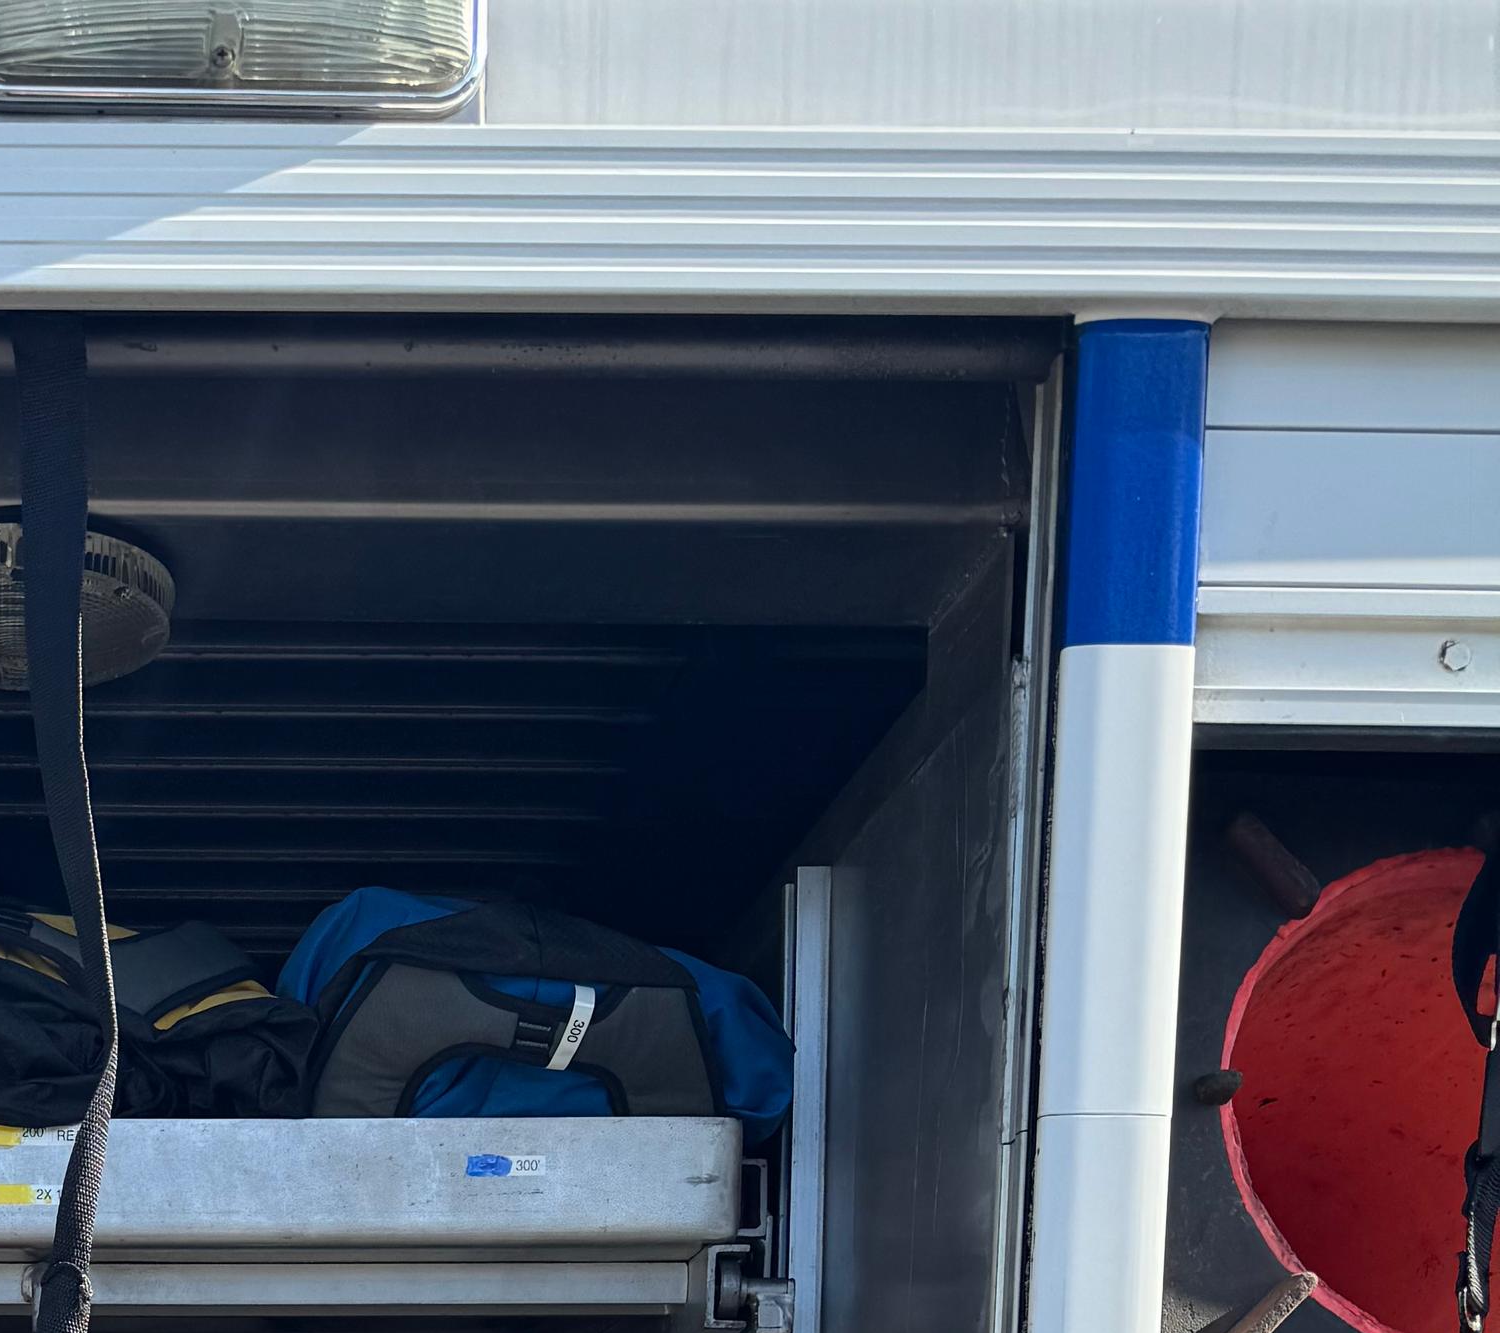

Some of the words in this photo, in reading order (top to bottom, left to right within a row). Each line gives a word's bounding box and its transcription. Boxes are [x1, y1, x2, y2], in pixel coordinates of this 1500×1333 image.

[567, 1019, 585, 1043] 300
[515, 1160, 541, 1171] 300'
[36, 1189, 52, 1200] 2X
